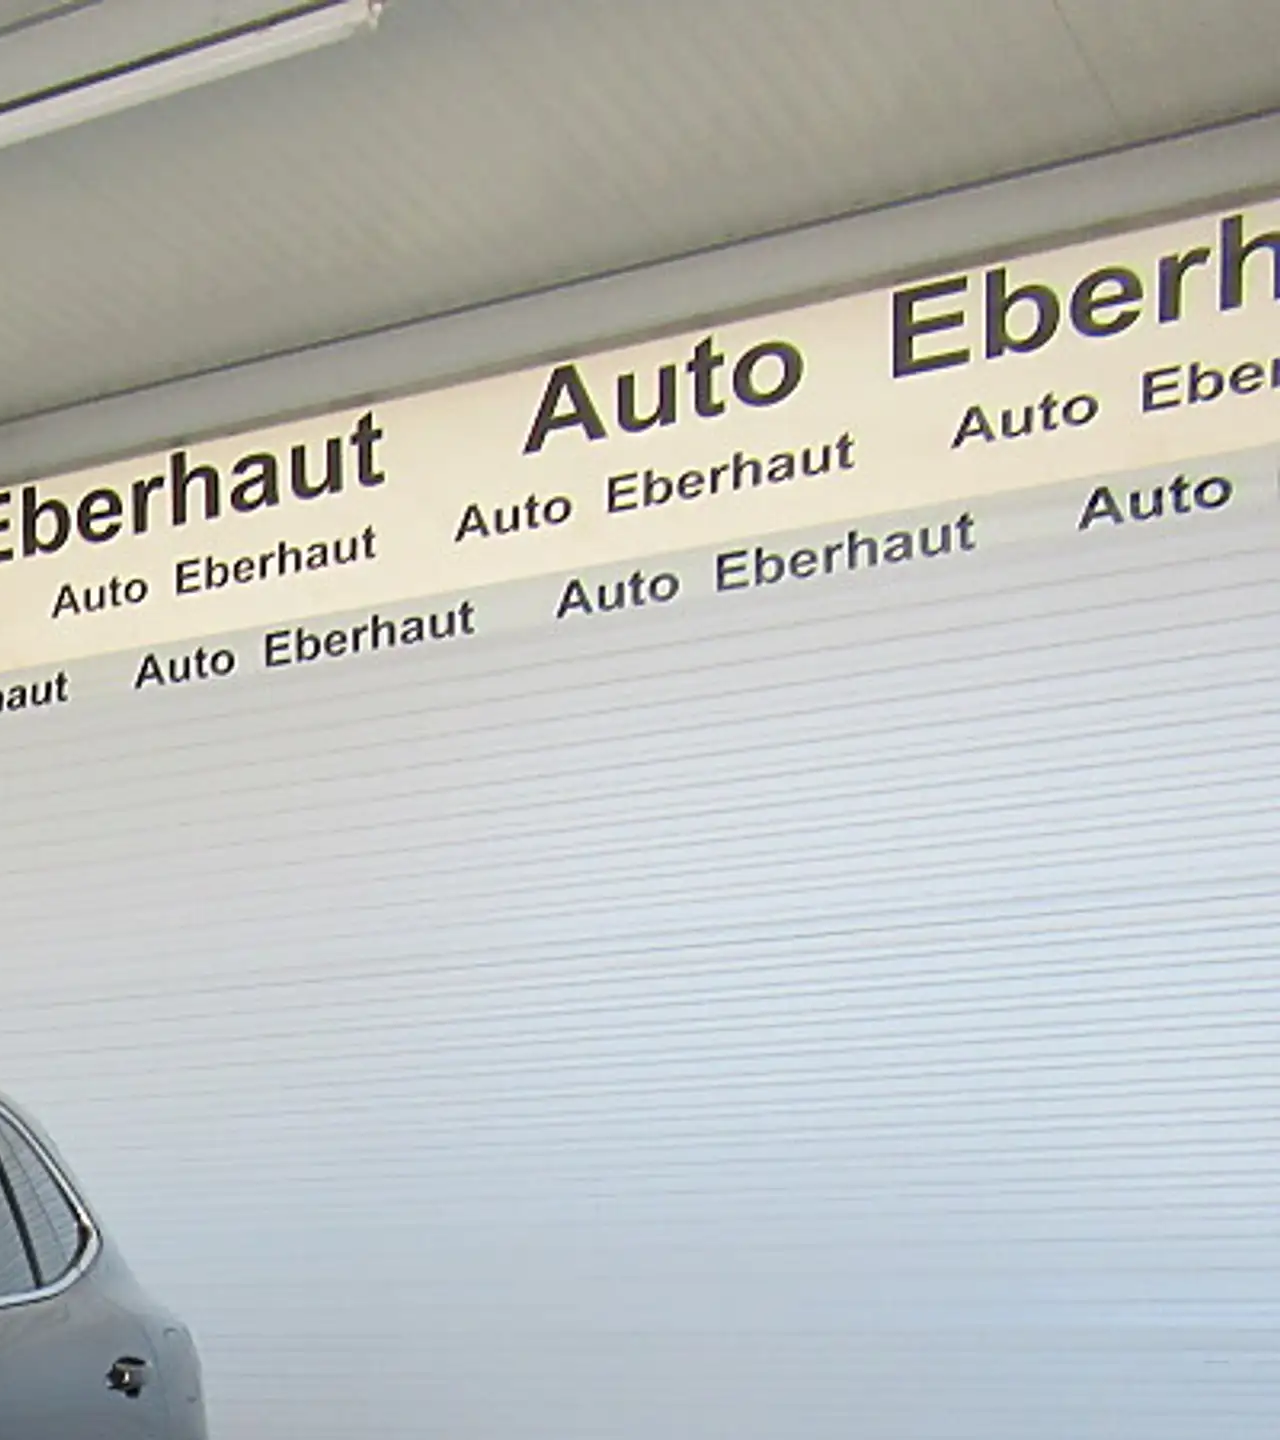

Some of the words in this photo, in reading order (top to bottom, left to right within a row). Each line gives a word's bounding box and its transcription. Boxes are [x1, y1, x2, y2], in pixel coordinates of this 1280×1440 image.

[523, 336, 803, 454] Auto
[951, 394, 1098, 448] Auto
[455, 495, 571, 542] Auto
[608, 433, 854, 513] Eberhaut
[1079, 476, 1232, 530] Auto
[52, 577, 148, 618] Auto
[176, 526, 375, 595] Eberhaut
[557, 571, 678, 618] Auto
[717, 512, 975, 592] Eberhaut
[135, 648, 234, 689] Auto
[266, 601, 474, 667] Eberhaut
